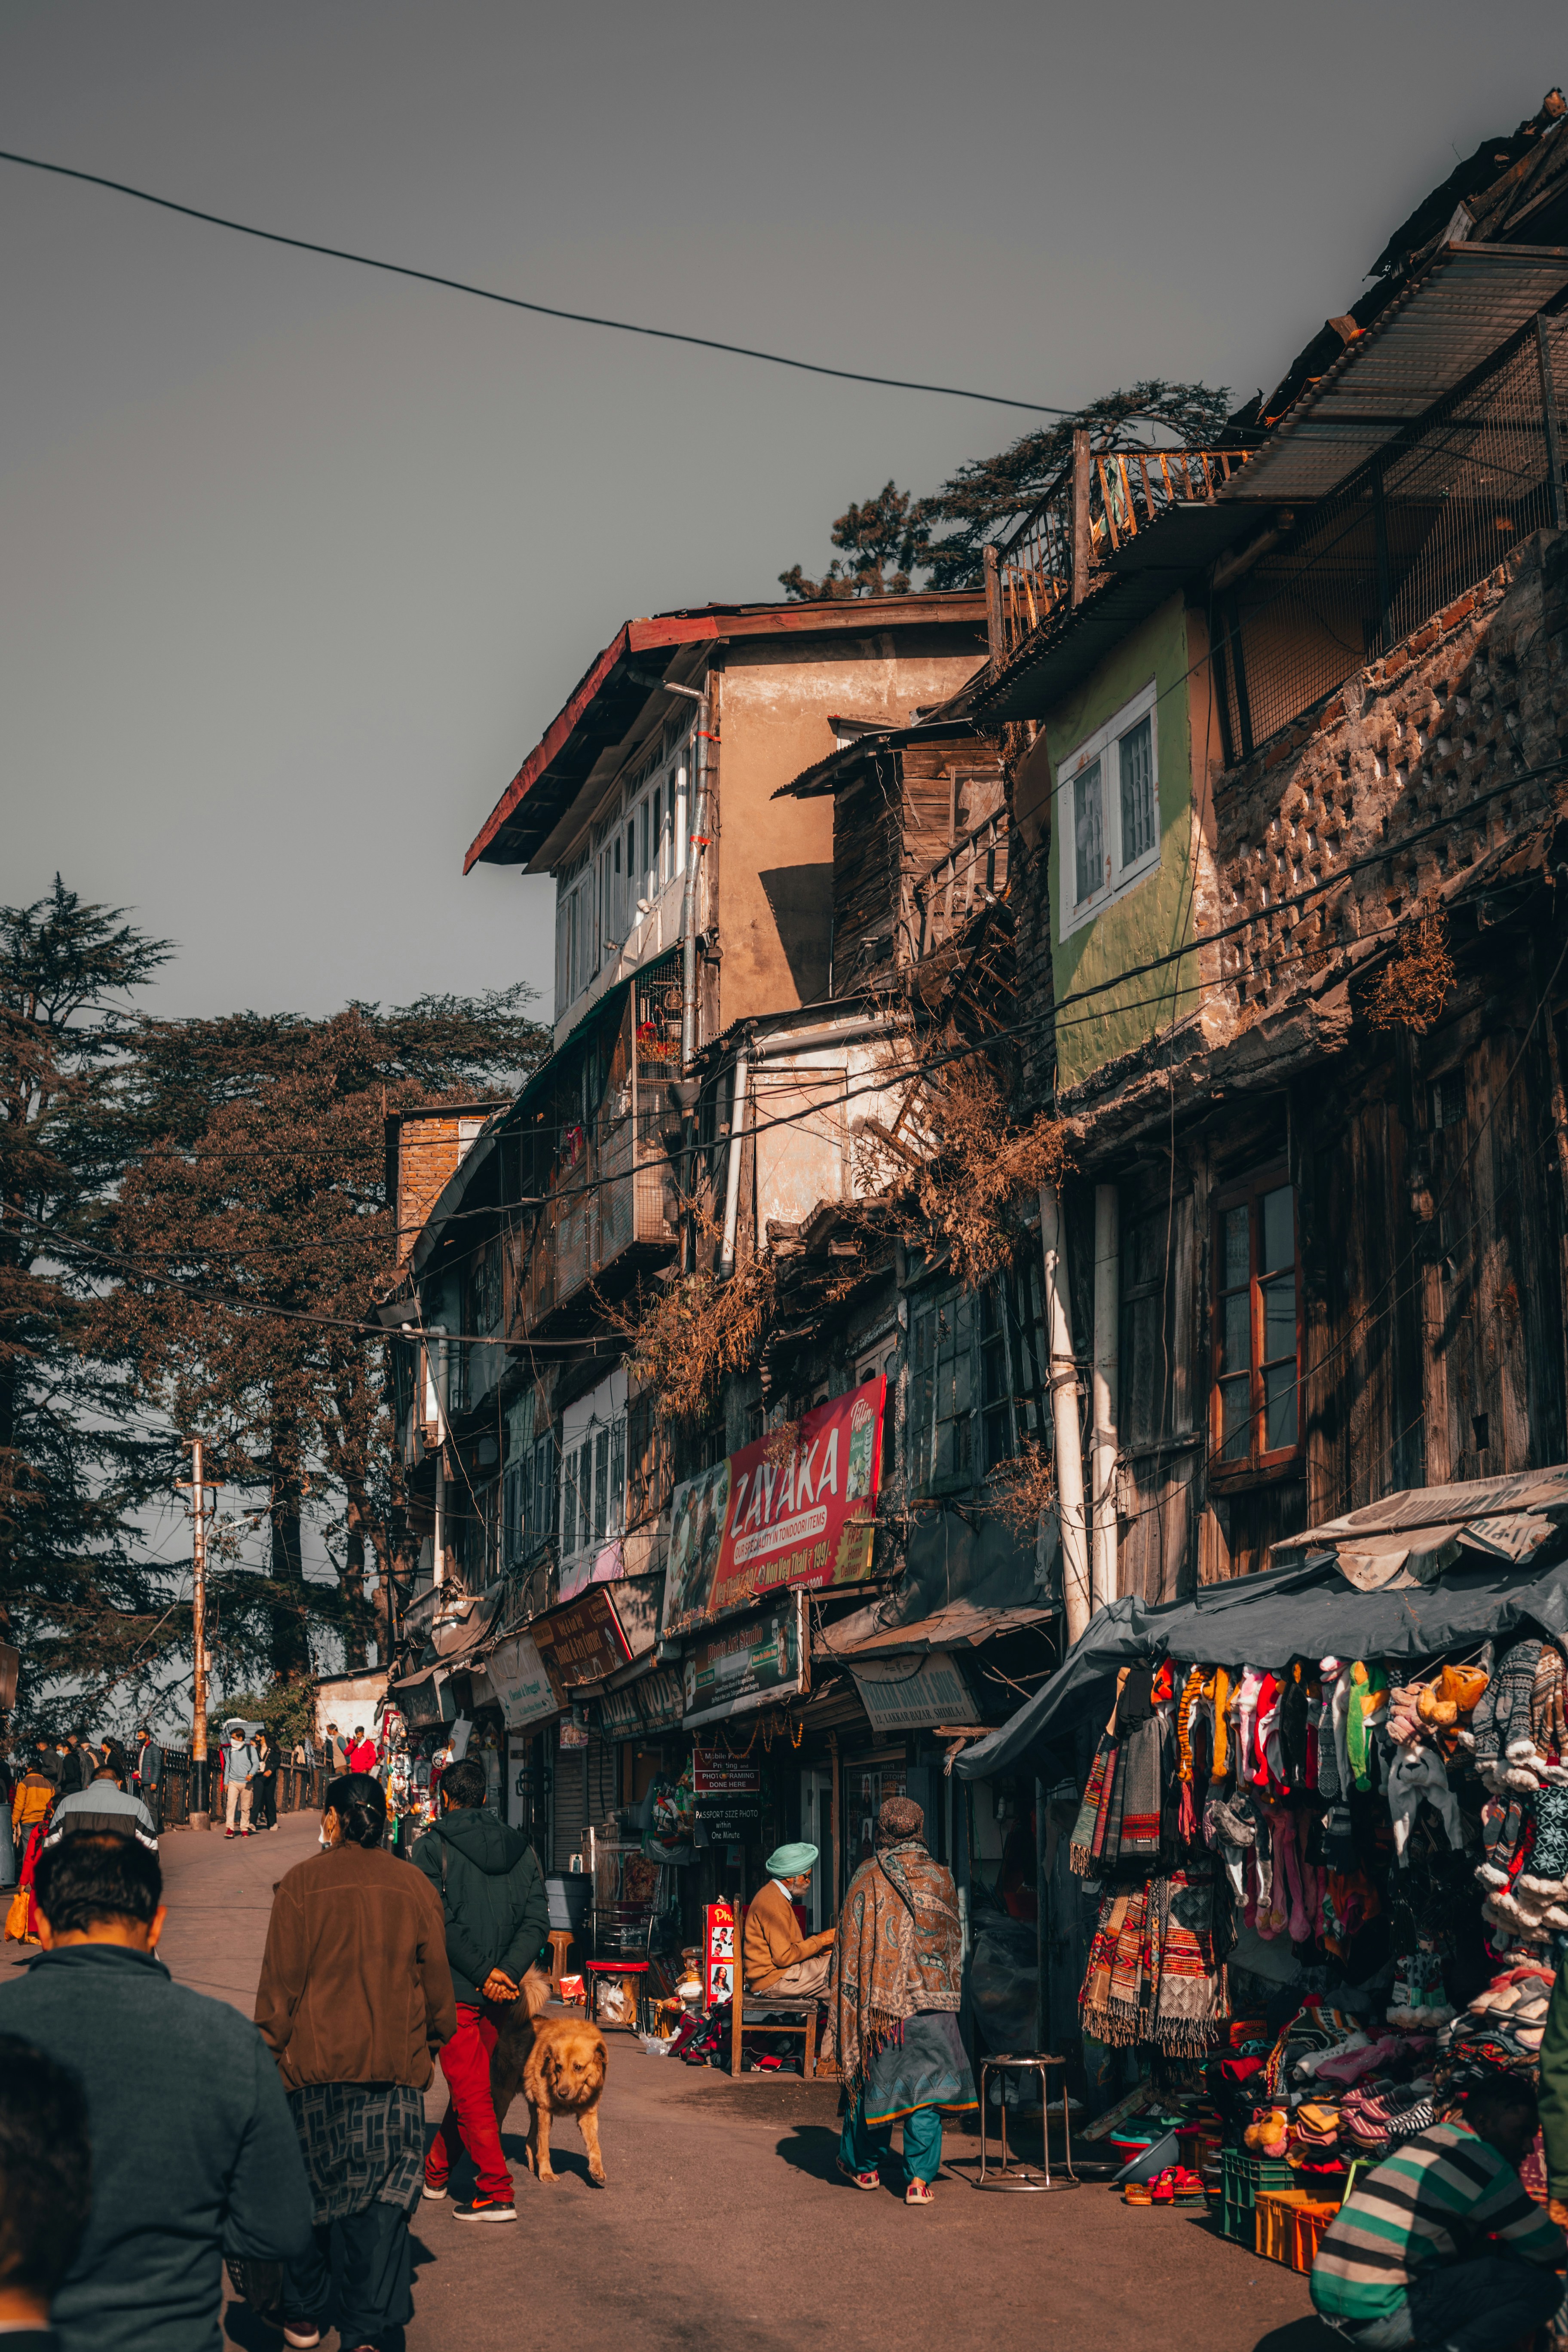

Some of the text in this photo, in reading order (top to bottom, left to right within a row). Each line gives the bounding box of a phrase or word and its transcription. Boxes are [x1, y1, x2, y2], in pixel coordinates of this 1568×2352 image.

[851, 1399, 873, 1433] Tiffin
[731, 1428, 839, 1539] ZAYAKA
[735, 1511, 825, 1559] OUR SPECIALITY IN TONDOORI ITEMS
[847, 1527, 863, 1545] FREE
[765, 1561, 778, 1586] Non
[778, 1556, 791, 1582] Veg
[791, 1548, 807, 1577] Thali
[841, 1562, 861, 1578] Delivery
[848, 1547, 862, 1561] Home
[557, 1613, 585, 1637] Veg & Non Veg
[554, 1629, 603, 1665] Roast & Fry Corner
[707, 1639, 726, 1663] Photo
[727, 1633, 738, 1655] Art
[739, 1623, 763, 1650] Studio
[524, 1679, 541, 1697] Druggist
[894, 1674, 929, 1709] SINGH
[921, 1673, 937, 1705] &
[929, 1670, 962, 1705] SONS
[599, 1688, 638, 1729] INDIA
[875, 1706, 967, 1725] 12, LAKKAR BAZAR, SHIMLA-1
[696, 1811, 723, 1819] PASSPORT
